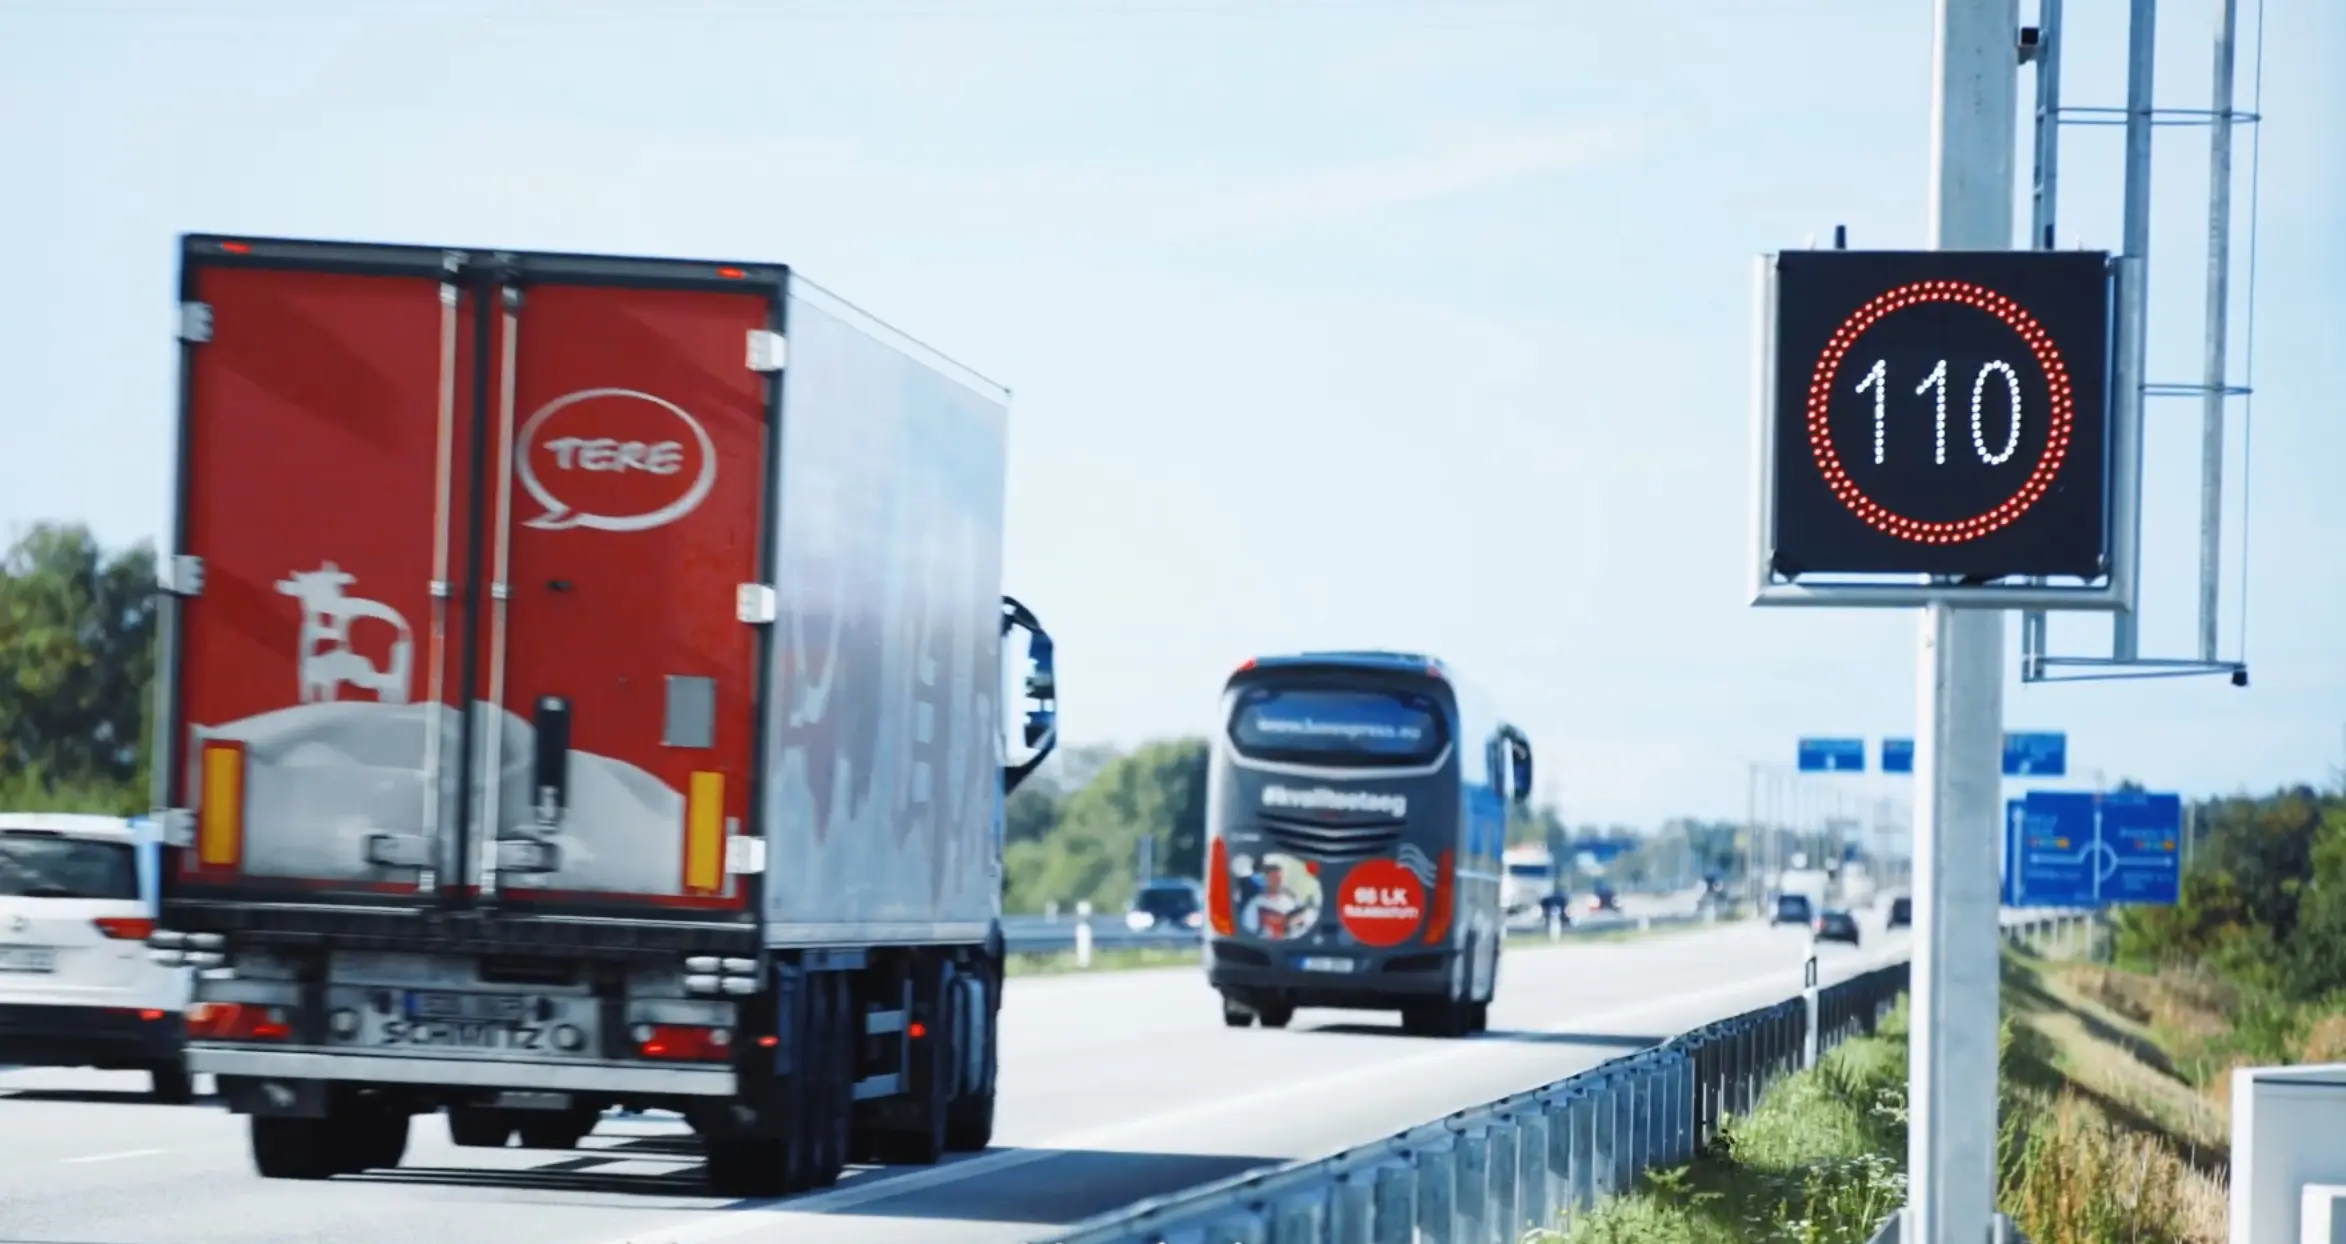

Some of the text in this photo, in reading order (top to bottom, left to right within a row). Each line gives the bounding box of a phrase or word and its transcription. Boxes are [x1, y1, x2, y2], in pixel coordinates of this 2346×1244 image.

[1855, 359, 2021, 464] 110
[542, 436, 684, 475] TERE
[381, 1019, 545, 1050] SCHMITZ
